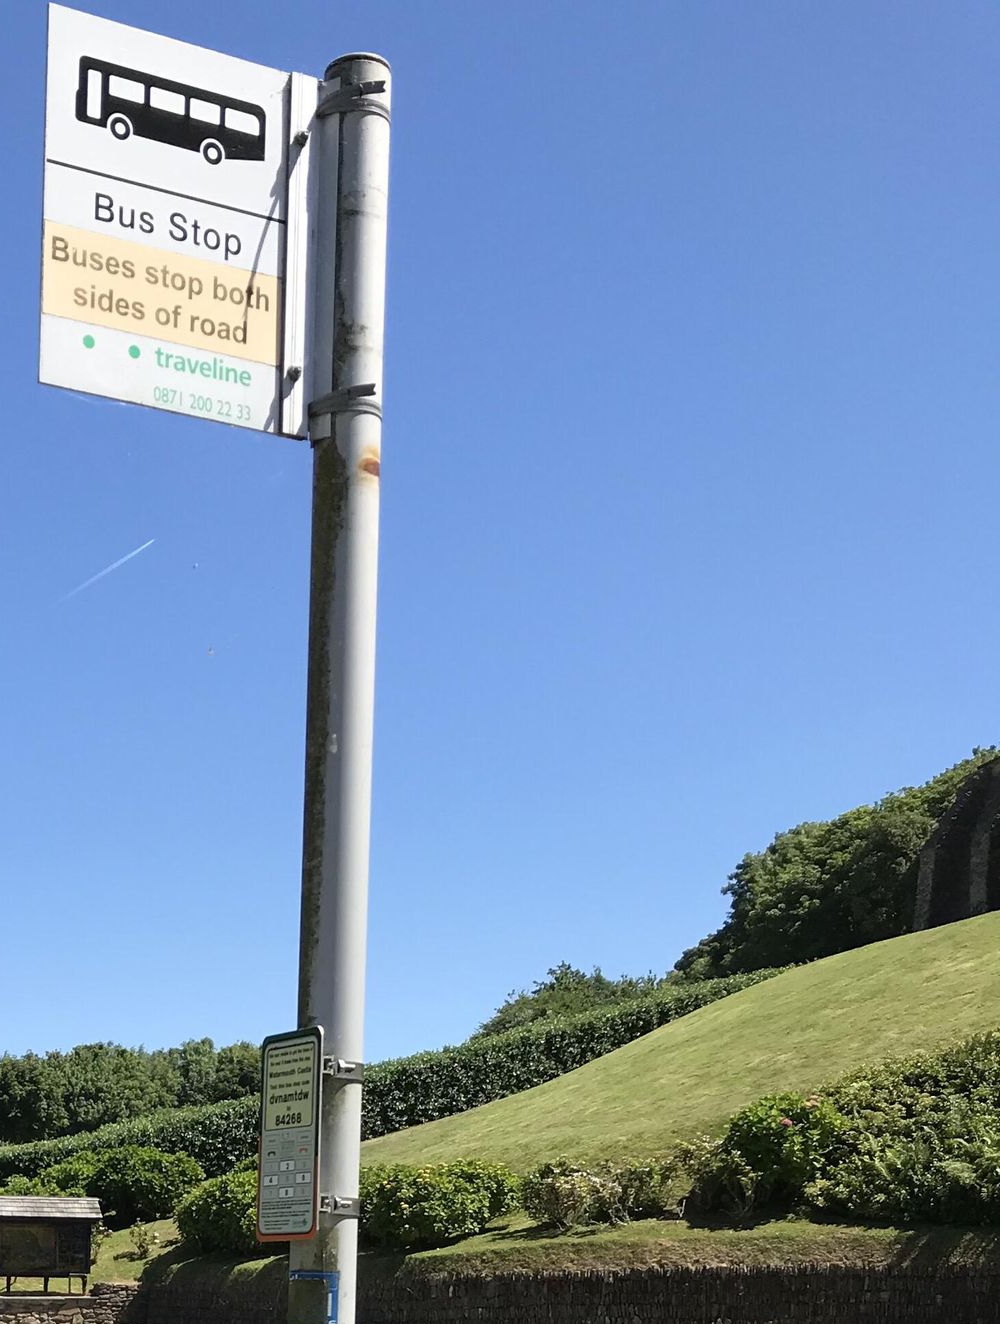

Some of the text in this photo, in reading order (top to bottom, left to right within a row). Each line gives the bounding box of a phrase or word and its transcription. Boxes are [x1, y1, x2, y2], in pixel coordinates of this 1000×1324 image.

[94, 192, 243, 260] Bus Stop
[51, 236, 271, 313] Buses stop both
[73, 285, 248, 345] sides of road
[154, 347, 252, 387] traveline
[153, 386, 252, 422] 0871 200 22 33
